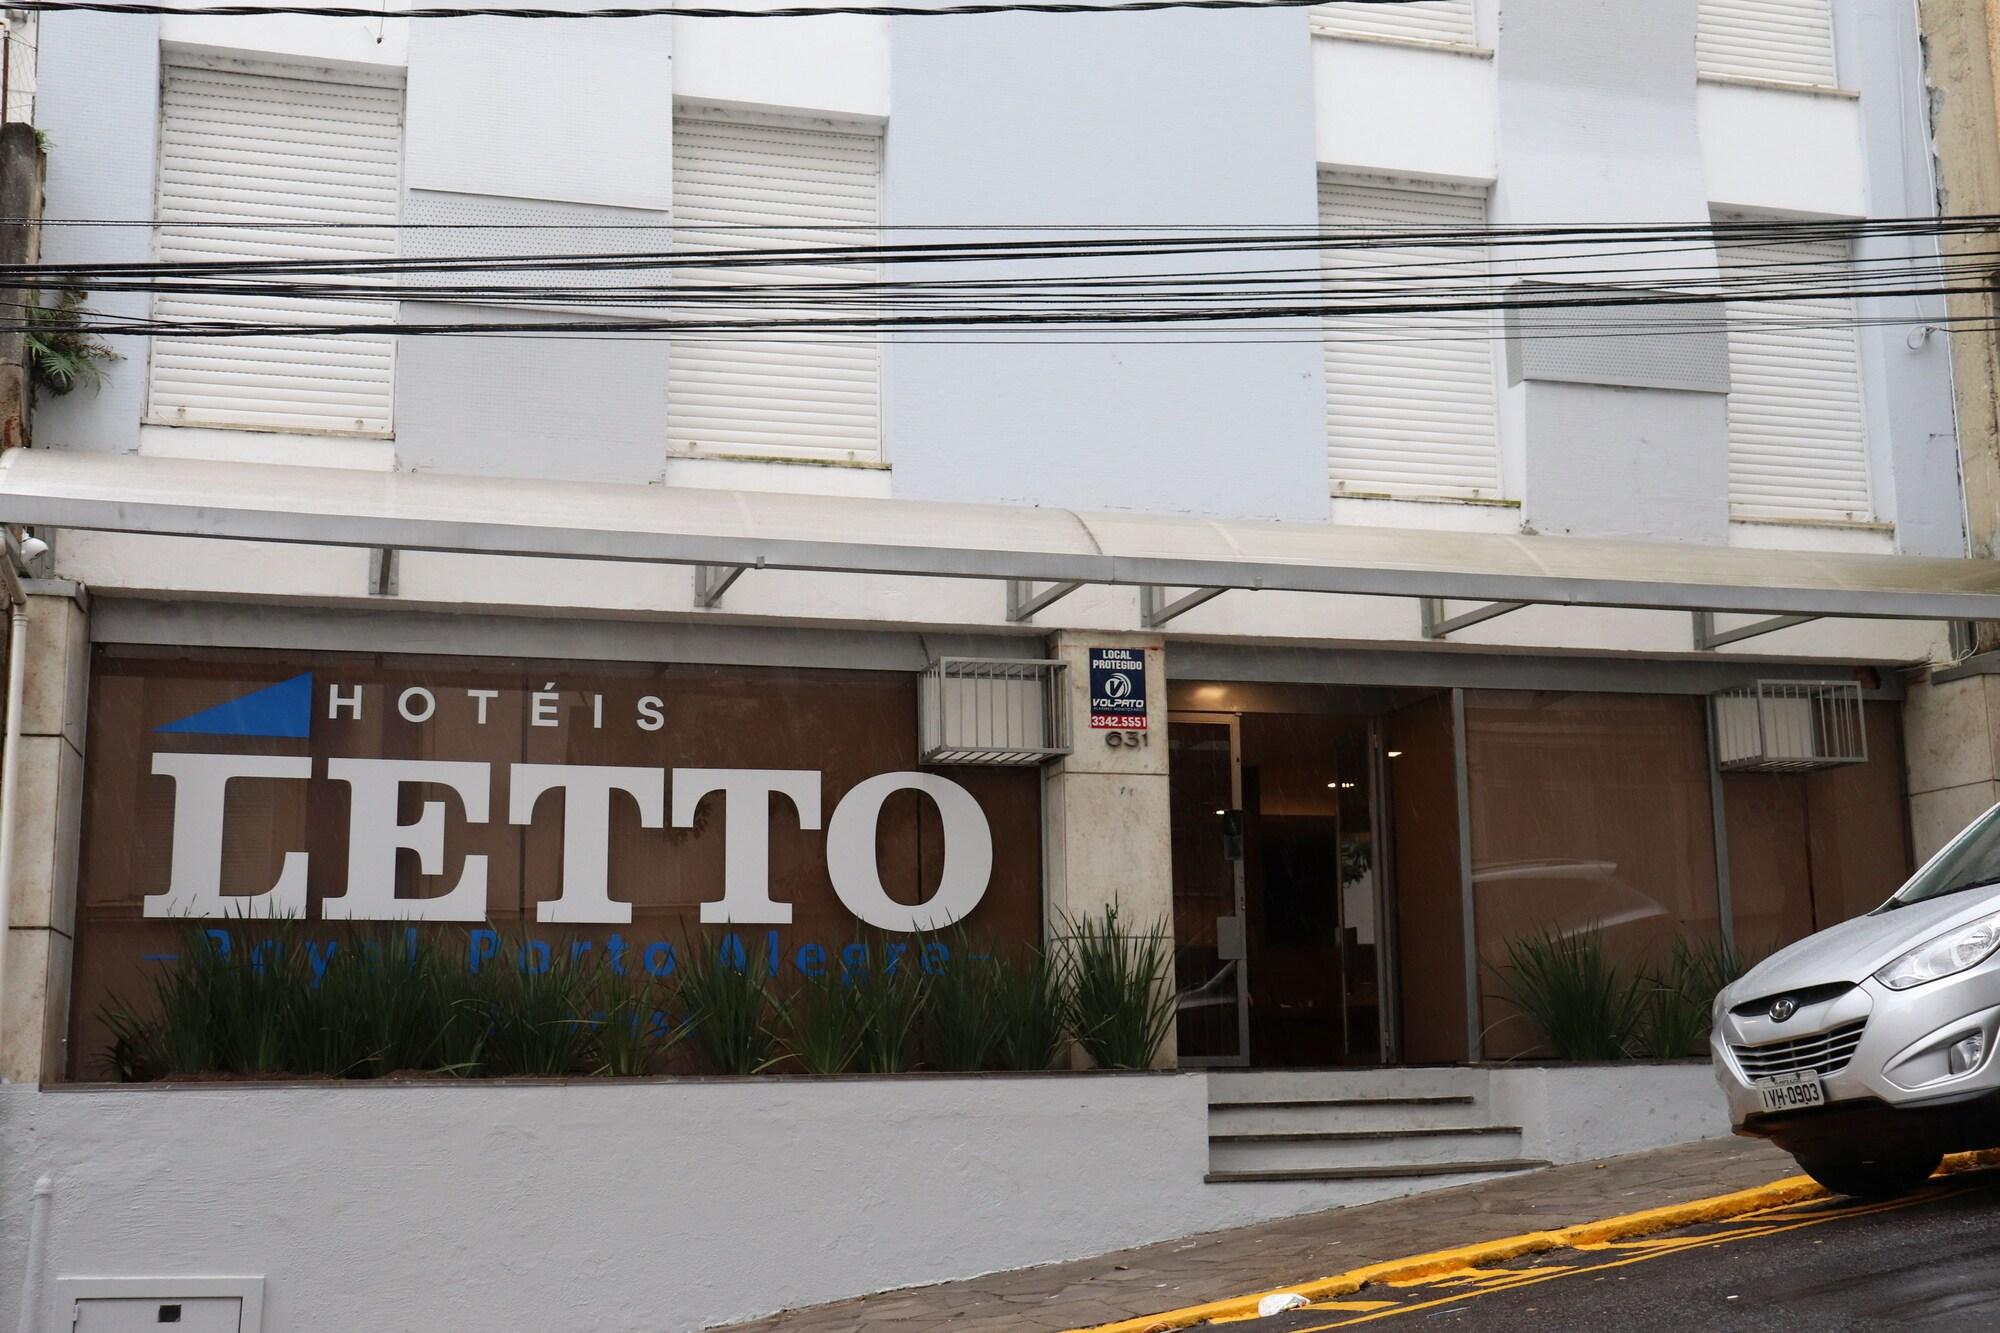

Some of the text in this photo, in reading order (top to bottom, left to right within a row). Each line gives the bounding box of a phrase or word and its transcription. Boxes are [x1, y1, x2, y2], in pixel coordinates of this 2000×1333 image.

[1102, 649, 1132, 660] LOCAL
[1092, 659, 1143, 670] PROTEGIDO
[329, 682, 665, 731] HOTÉIS
[1092, 698, 1144, 708] VOLPATO
[1091, 715, 1147, 727] 3342.5551
[1105, 731, 1148, 748] 631
[143, 752, 993, 932] LETTO
[468, 928, 678, 977] Porto
[717, 929, 951, 988] Alegre
